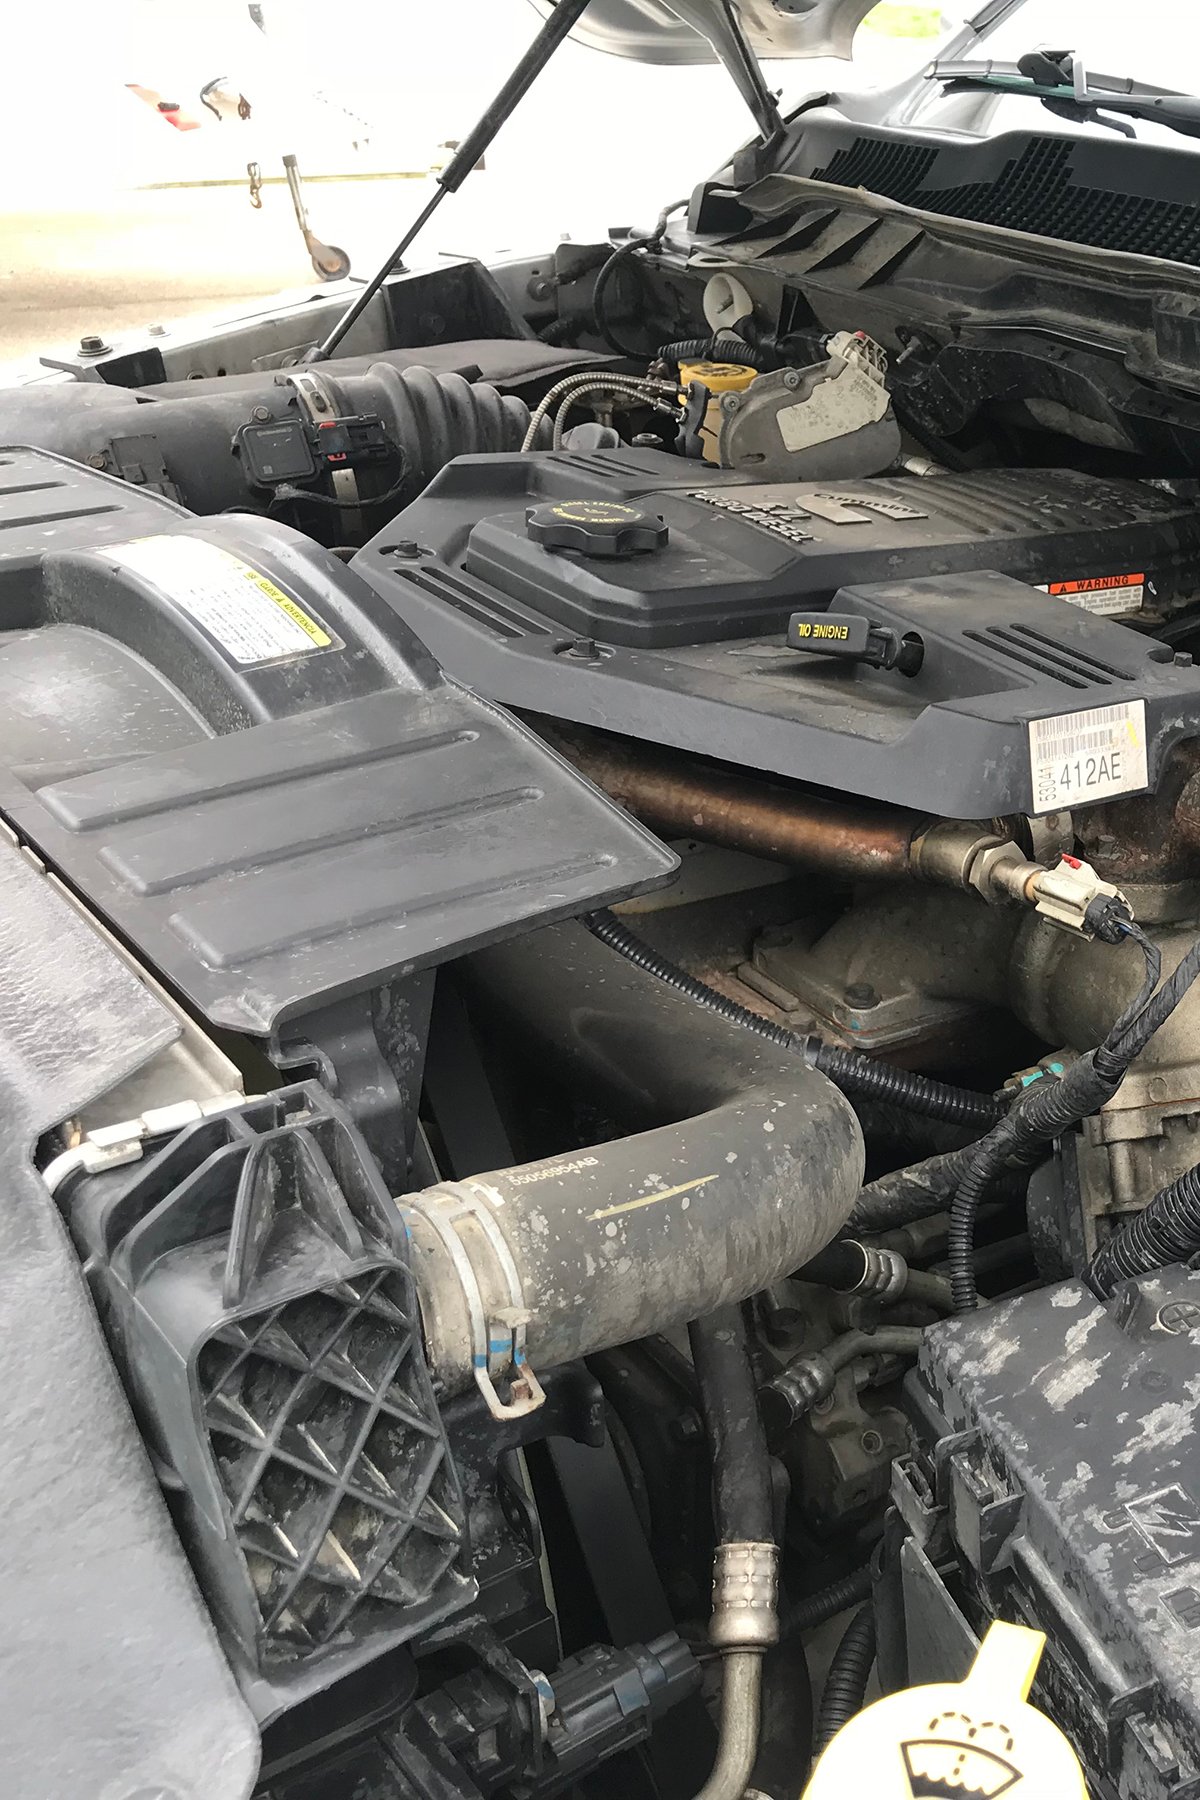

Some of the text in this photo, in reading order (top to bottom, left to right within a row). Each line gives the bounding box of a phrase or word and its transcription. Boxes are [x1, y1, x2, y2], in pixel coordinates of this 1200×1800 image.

[742, 512, 813, 542] DIESEL
[1077, 576, 1128, 589] WARNING
[798, 624, 848, 639] ENGINE OIL
[1038, 765, 1057, 802] 53041
[1060, 752, 1122, 791] 412AE
